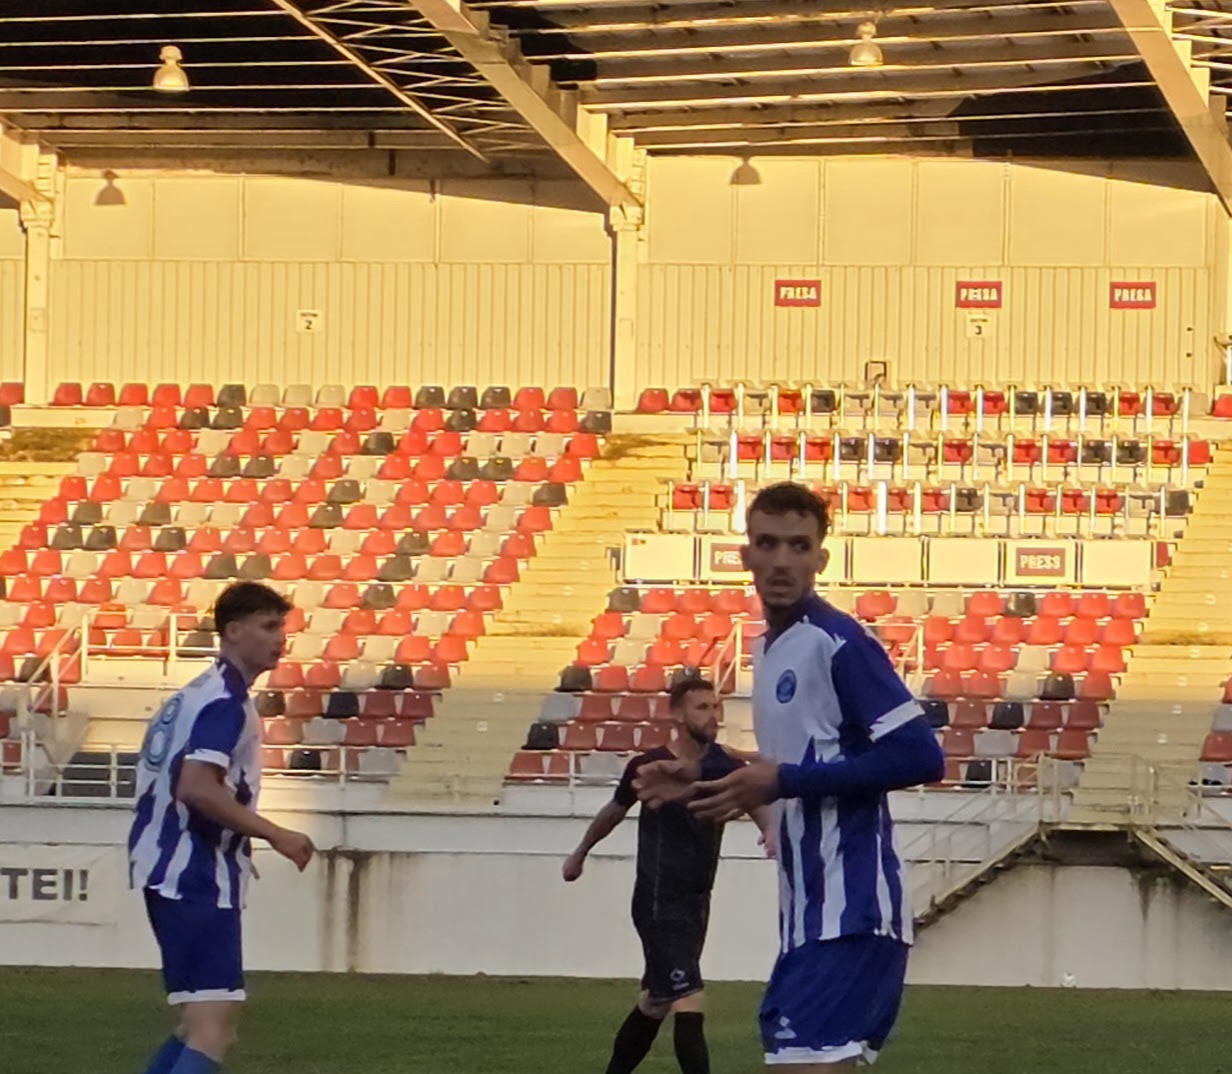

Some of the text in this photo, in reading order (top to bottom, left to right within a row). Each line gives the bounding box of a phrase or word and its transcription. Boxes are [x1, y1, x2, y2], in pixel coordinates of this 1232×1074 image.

[780, 286, 817, 300] PRESA
[960, 287, 998, 301] PRESA
[1114, 288, 1153, 302] PRESA
[1020, 554, 1061, 570] PRESS
[0, 867, 89, 901] TEI!
